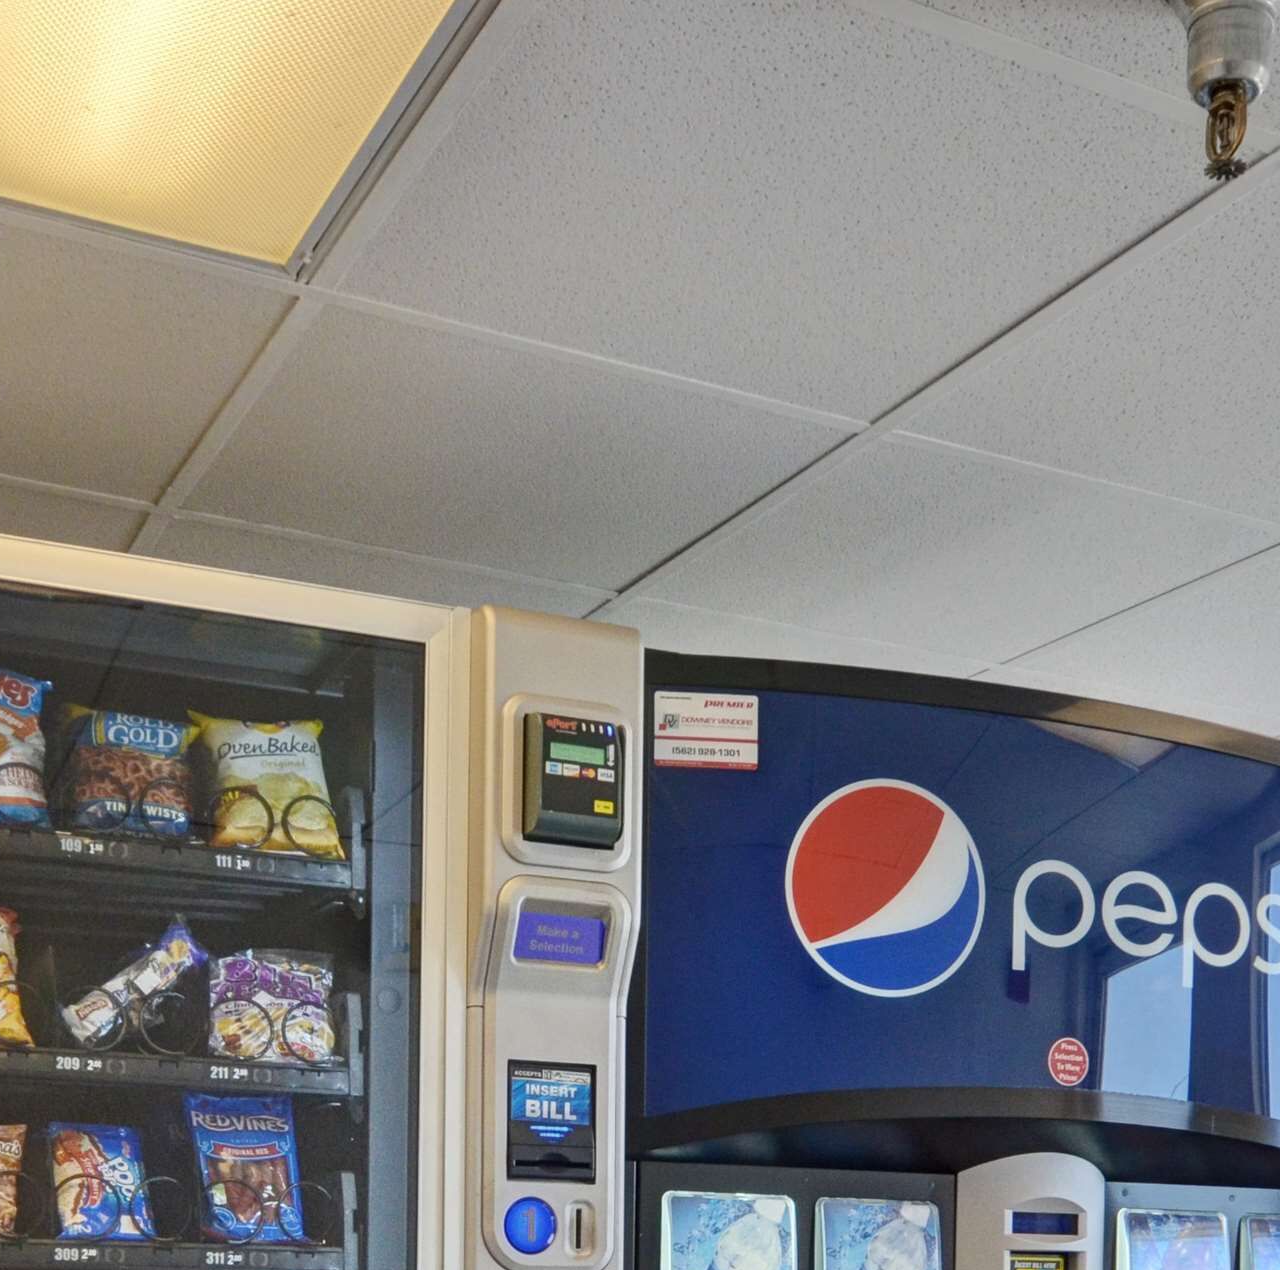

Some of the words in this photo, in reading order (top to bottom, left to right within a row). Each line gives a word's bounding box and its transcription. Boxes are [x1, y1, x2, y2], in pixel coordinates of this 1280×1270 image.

[108, 726, 178, 748] GOLD
[219, 743, 265, 759] Oven
[261, 759, 305, 769] Original
[60, 839, 82, 852] 109
[216, 855, 232, 868] 111
[538, 925, 566, 938] Make
[529, 940, 584, 954] Selection
[56, 1057, 80, 1070] 209
[211, 1066, 228, 1079] 211
[525, 1083, 577, 1099] INSERT
[525, 1100, 577, 1120] BILL
[190, 1110, 230, 1130] RED
[231, 1116, 289, 1132] VINES
[522, 1206, 537, 1242] 1
[54, 1248, 79, 1261] 309
[206, 1251, 225, 1265] 311
